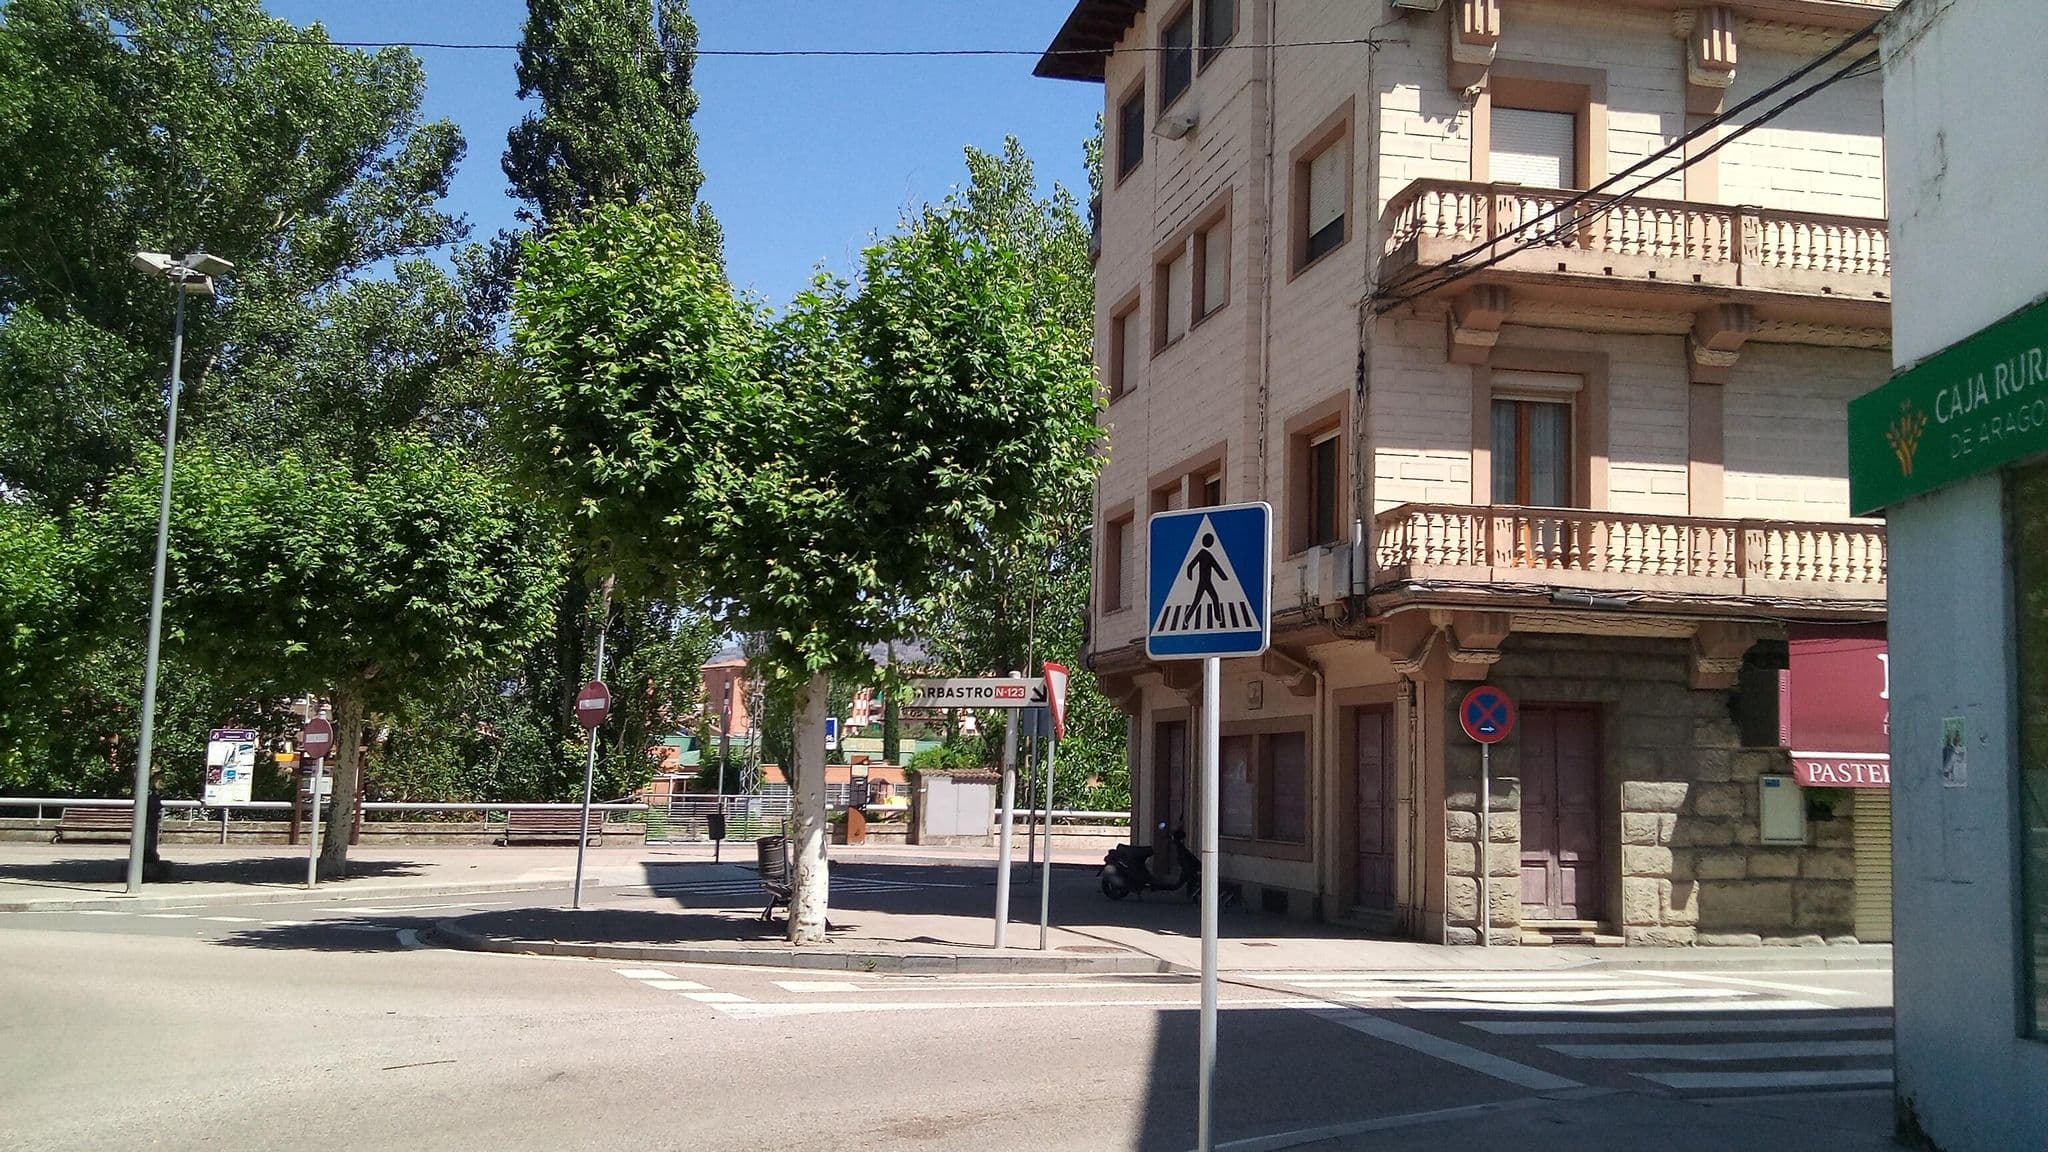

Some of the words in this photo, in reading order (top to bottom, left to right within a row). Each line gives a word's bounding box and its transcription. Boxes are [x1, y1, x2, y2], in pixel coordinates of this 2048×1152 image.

[1936, 372, 1989, 424] CAJA
[1995, 347, 2048, 399] RUR
[1951, 427, 1973, 459] DE
[995, 687, 1025, 698] N-123
